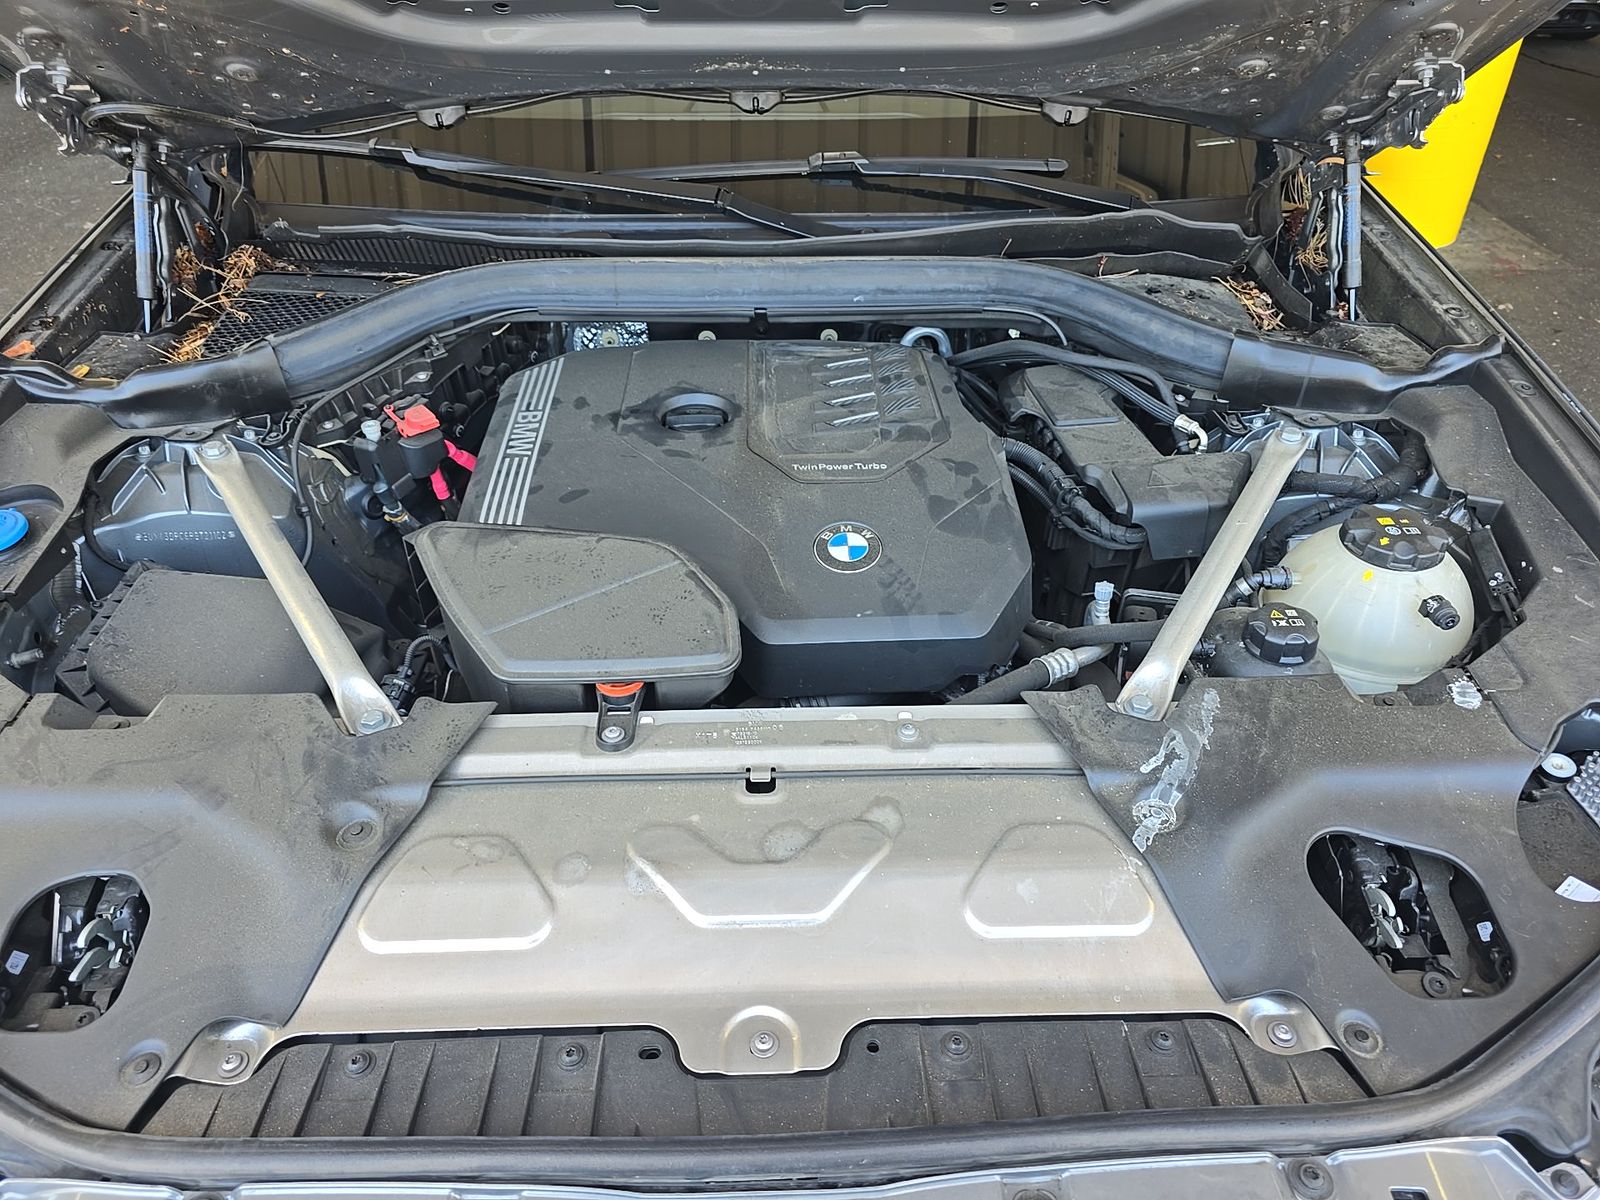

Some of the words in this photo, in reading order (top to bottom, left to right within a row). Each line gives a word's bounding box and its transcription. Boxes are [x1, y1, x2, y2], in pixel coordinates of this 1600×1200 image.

[506, 410, 543, 455] BMW
[854, 462, 887, 470] Turbo
[821, 524, 875, 540] BMW
